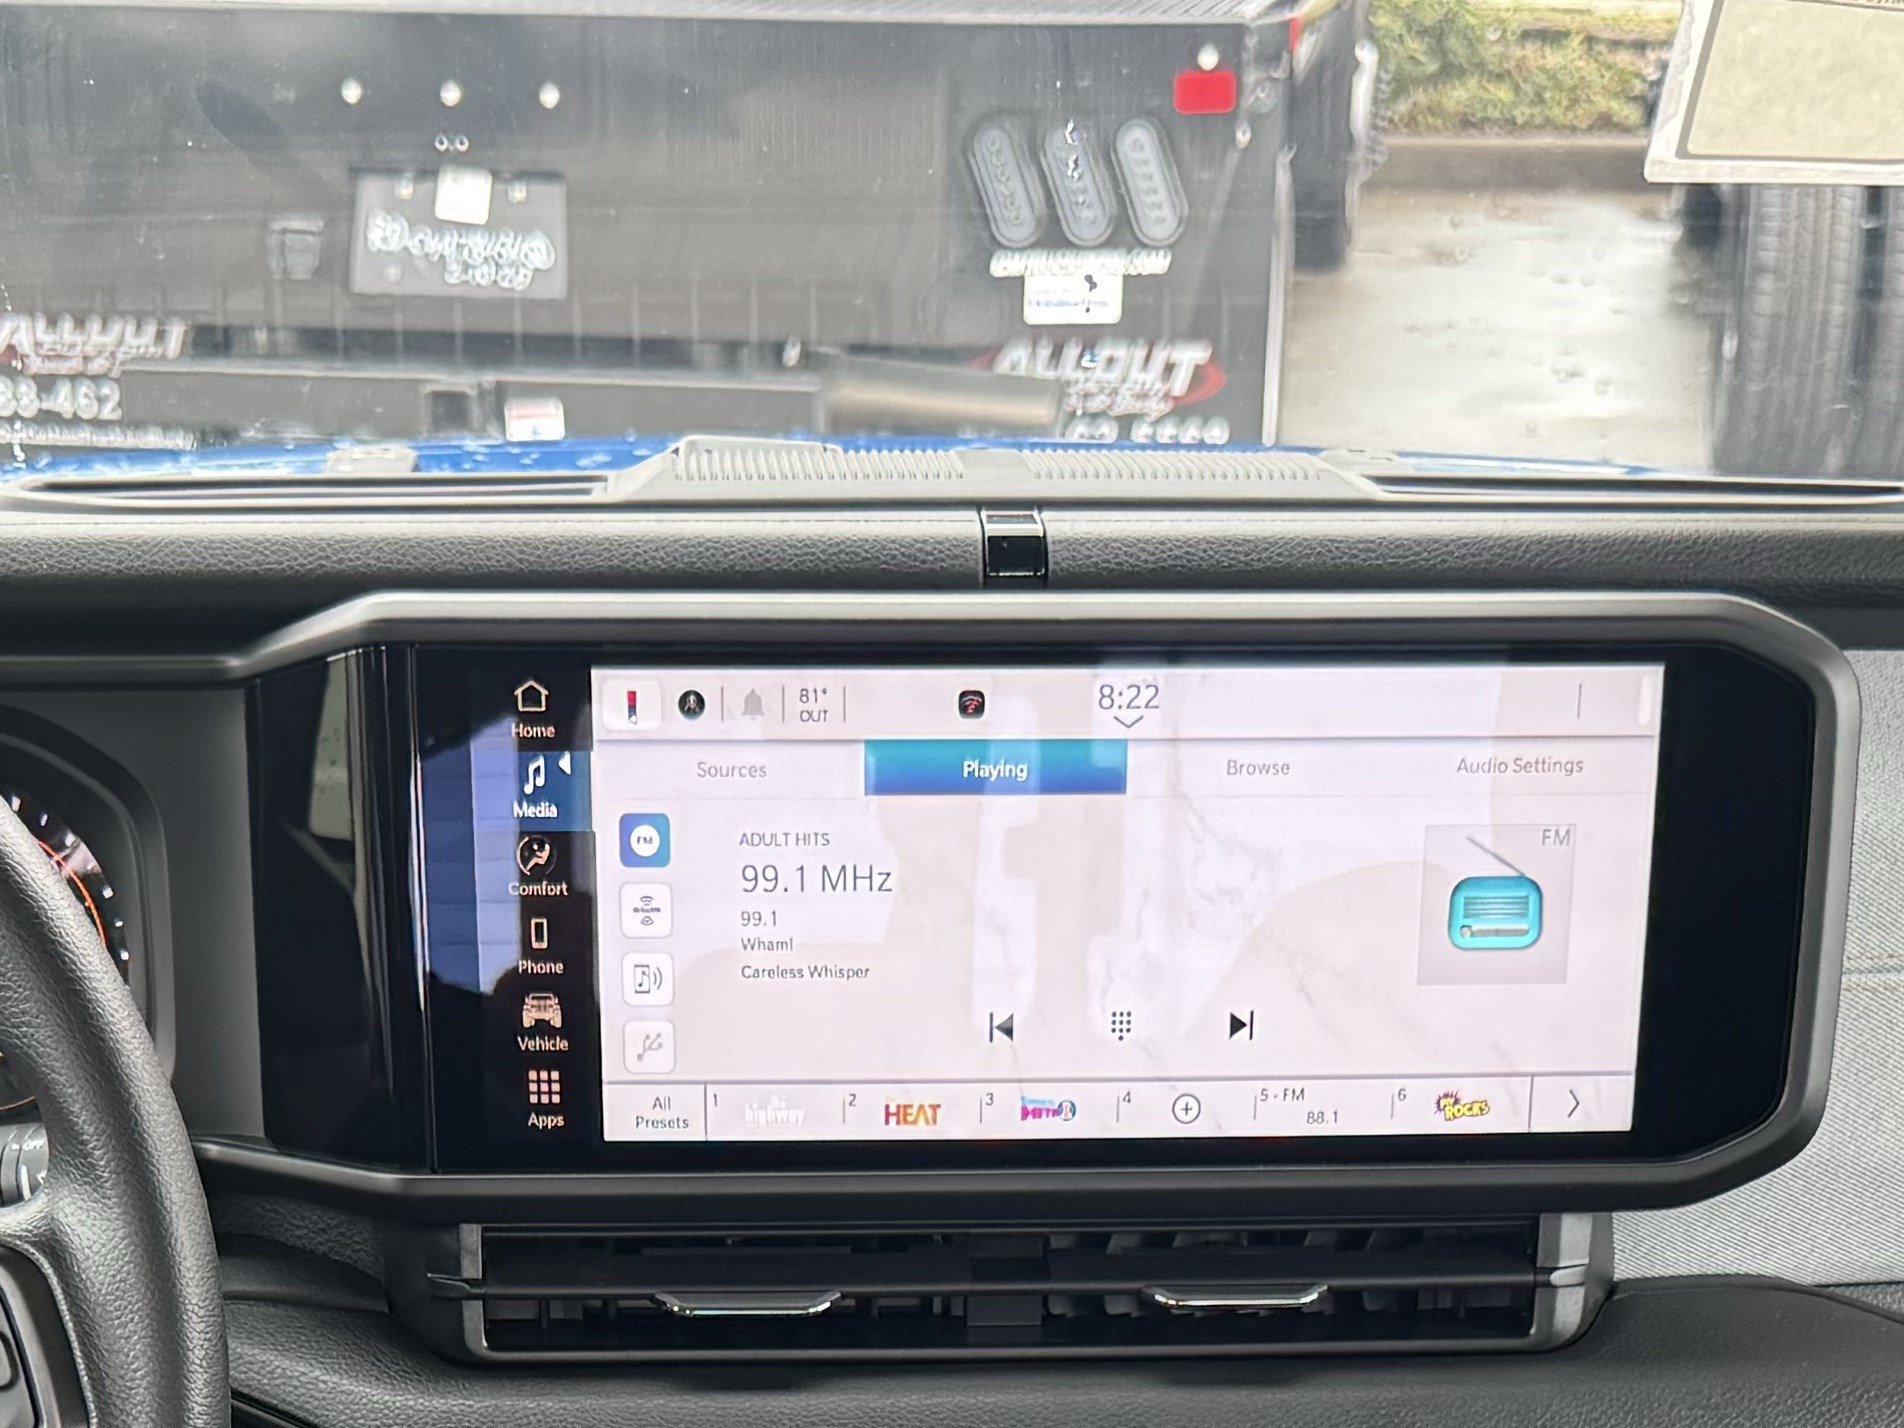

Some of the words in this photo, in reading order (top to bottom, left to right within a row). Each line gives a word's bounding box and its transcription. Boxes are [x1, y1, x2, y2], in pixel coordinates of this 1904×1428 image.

[992, 337, 1213, 396] ALLOUT
[797, 687, 828, 705] 81°
[1098, 684, 1160, 711] 8:22
[799, 710, 828, 723] OUT
[512, 722, 555, 739] Home
[696, 761, 768, 778] Sources
[962, 759, 1028, 782] Playing
[1226, 758, 1291, 778] Browse
[1456, 756, 1508, 776] Audio
[1512, 756, 1585, 779] Settings
[513, 802, 558, 819] Media
[739, 832, 789, 847] ADULT
[794, 832, 831, 847] HITS
[1541, 829, 1571, 846] FM
[741, 865, 808, 893] 99.1
[820, 865, 893, 893] MHz
[509, 880, 568, 897] Comfort
[741, 911, 778, 928] 99.1
[519, 959, 564, 975] Phone
[741, 964, 804, 980] Careless
[807, 963, 870, 982] Whisper
[518, 1035, 569, 1053] Vehicle
[712, 1093, 718, 1107] 1
[848, 1093, 857, 1108] 2
[986, 1093, 994, 1107] 3
[1122, 1091, 1132, 1104] 4
[1260, 1089, 1268, 1102] 5
[1283, 1088, 1305, 1101] FM
[1397, 1089, 1407, 1102] 6
[652, 1097, 672, 1111] All
[1445, 1100, 1490, 1121] ROCKS
[528, 1110, 565, 1130] Apps
[635, 1116, 690, 1129] Presets
[884, 1104, 941, 1125] HEAT
[1306, 1110, 1339, 1124] 88.1
